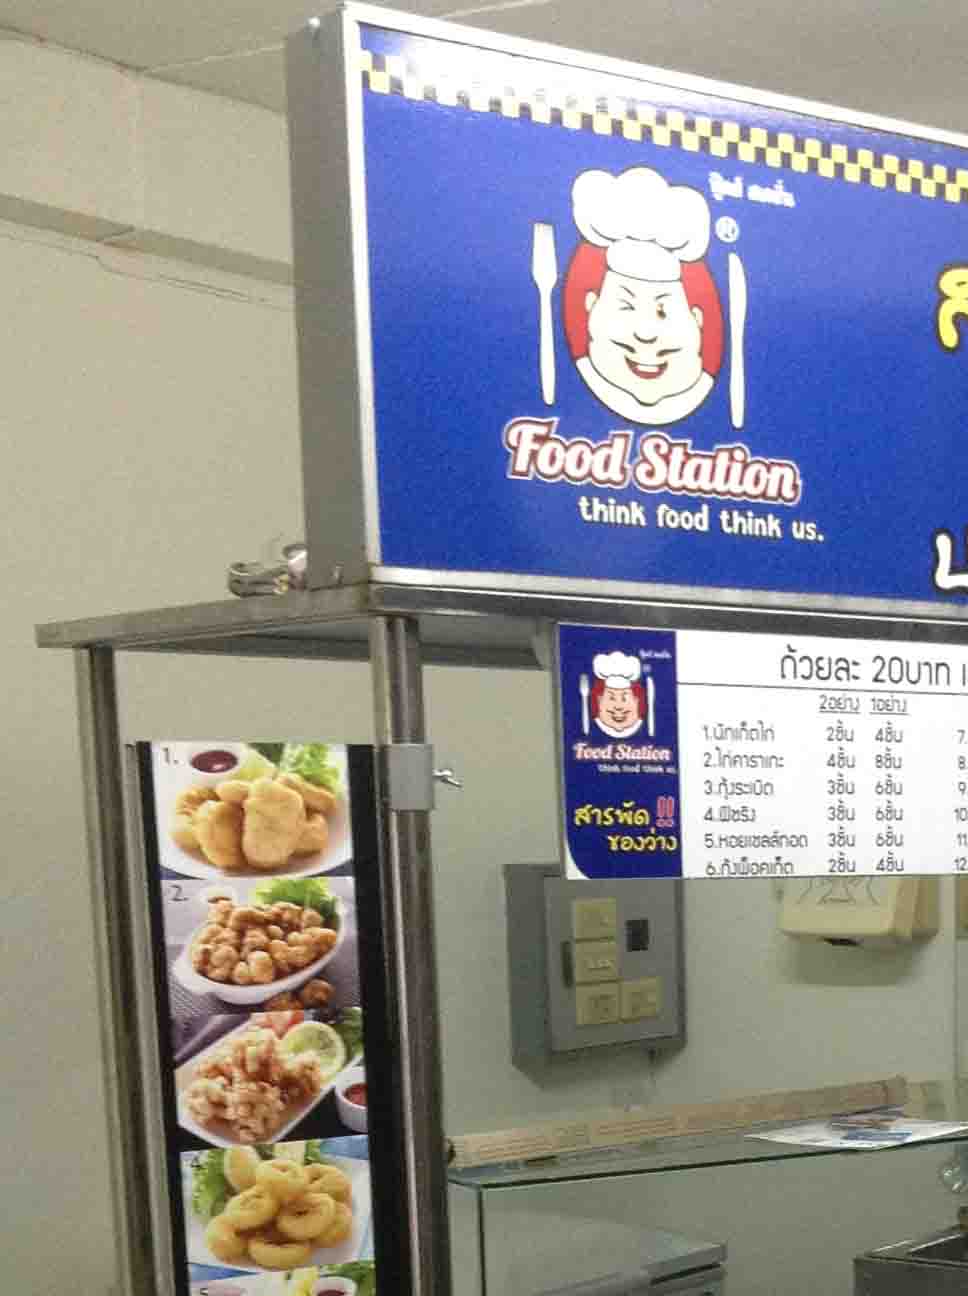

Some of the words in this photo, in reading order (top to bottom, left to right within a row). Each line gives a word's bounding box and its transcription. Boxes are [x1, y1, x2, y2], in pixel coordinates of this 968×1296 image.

[504, 417, 633, 489] Food
[635, 433, 801, 504] Station
[579, 495, 646, 527] think
[656, 503, 710, 531] food
[719, 504, 782, 539] think
[791, 520, 824, 541] us.
[871, 655, 951, 686] 20บาท
[574, 800, 650, 827] สารพัด
[607, 827, 678, 852] ของว่าง
